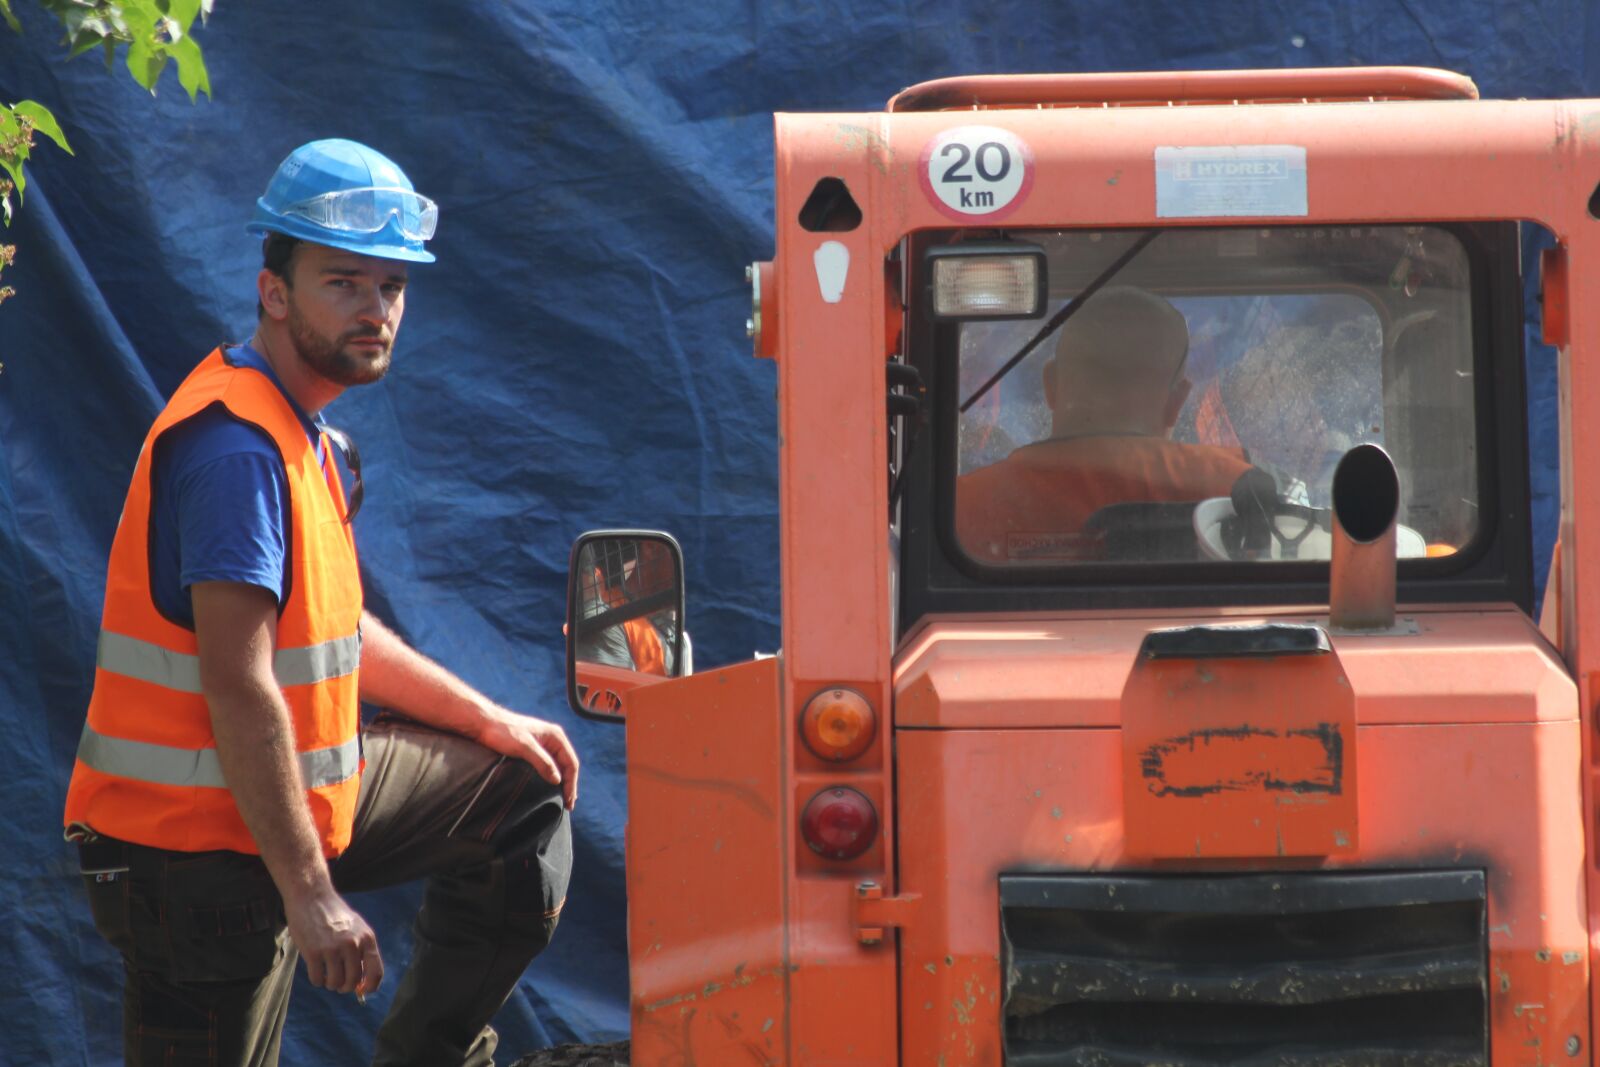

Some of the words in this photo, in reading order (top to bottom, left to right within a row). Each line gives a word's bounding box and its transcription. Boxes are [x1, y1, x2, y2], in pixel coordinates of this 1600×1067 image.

[941, 142, 1011, 183] 20
[1197, 162, 1280, 175] HYDREX
[960, 187, 994, 208] km
